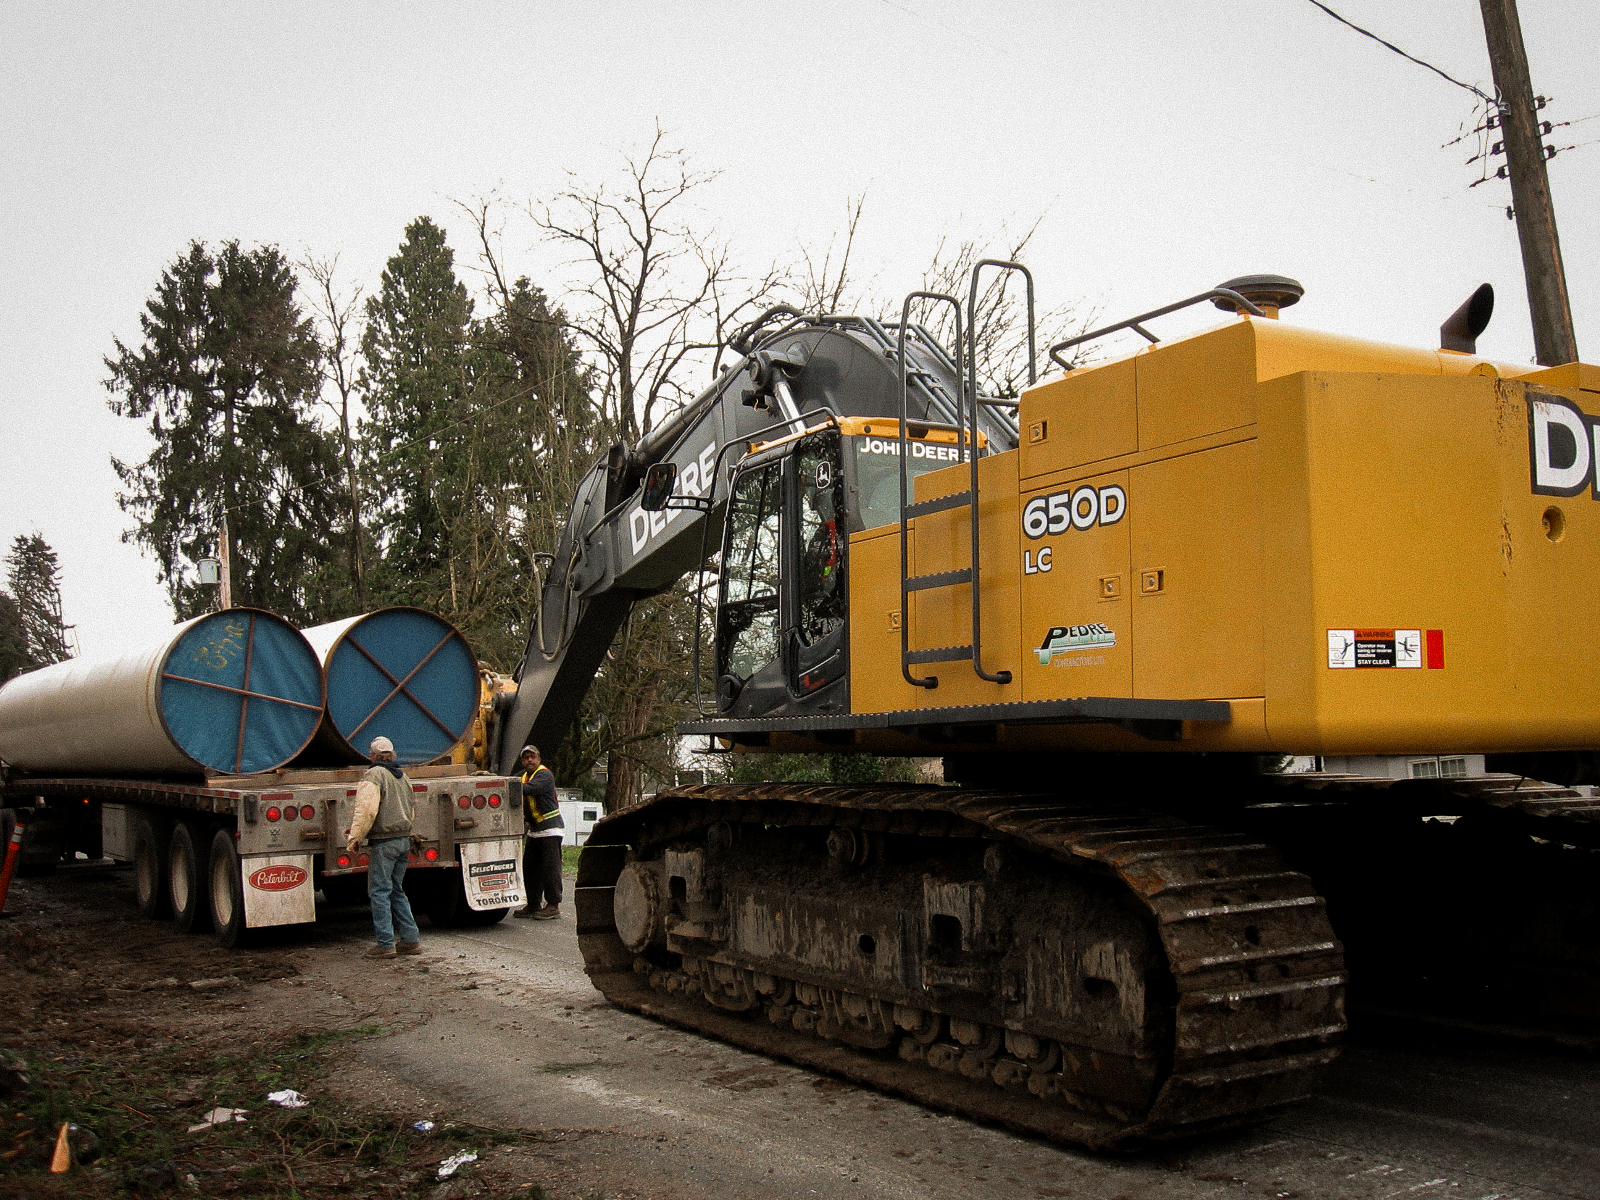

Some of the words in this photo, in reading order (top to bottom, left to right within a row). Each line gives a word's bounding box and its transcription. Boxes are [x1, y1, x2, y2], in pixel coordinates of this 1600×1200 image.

[1532, 400, 1600, 492] D
[1023, 485, 1126, 539] 650D
[1025, 546, 1052, 575] LC
[1041, 623, 1112, 650] PEDRE
[257, 871, 302, 886] Peterbilt
[476, 895, 519, 906] TORONTO
